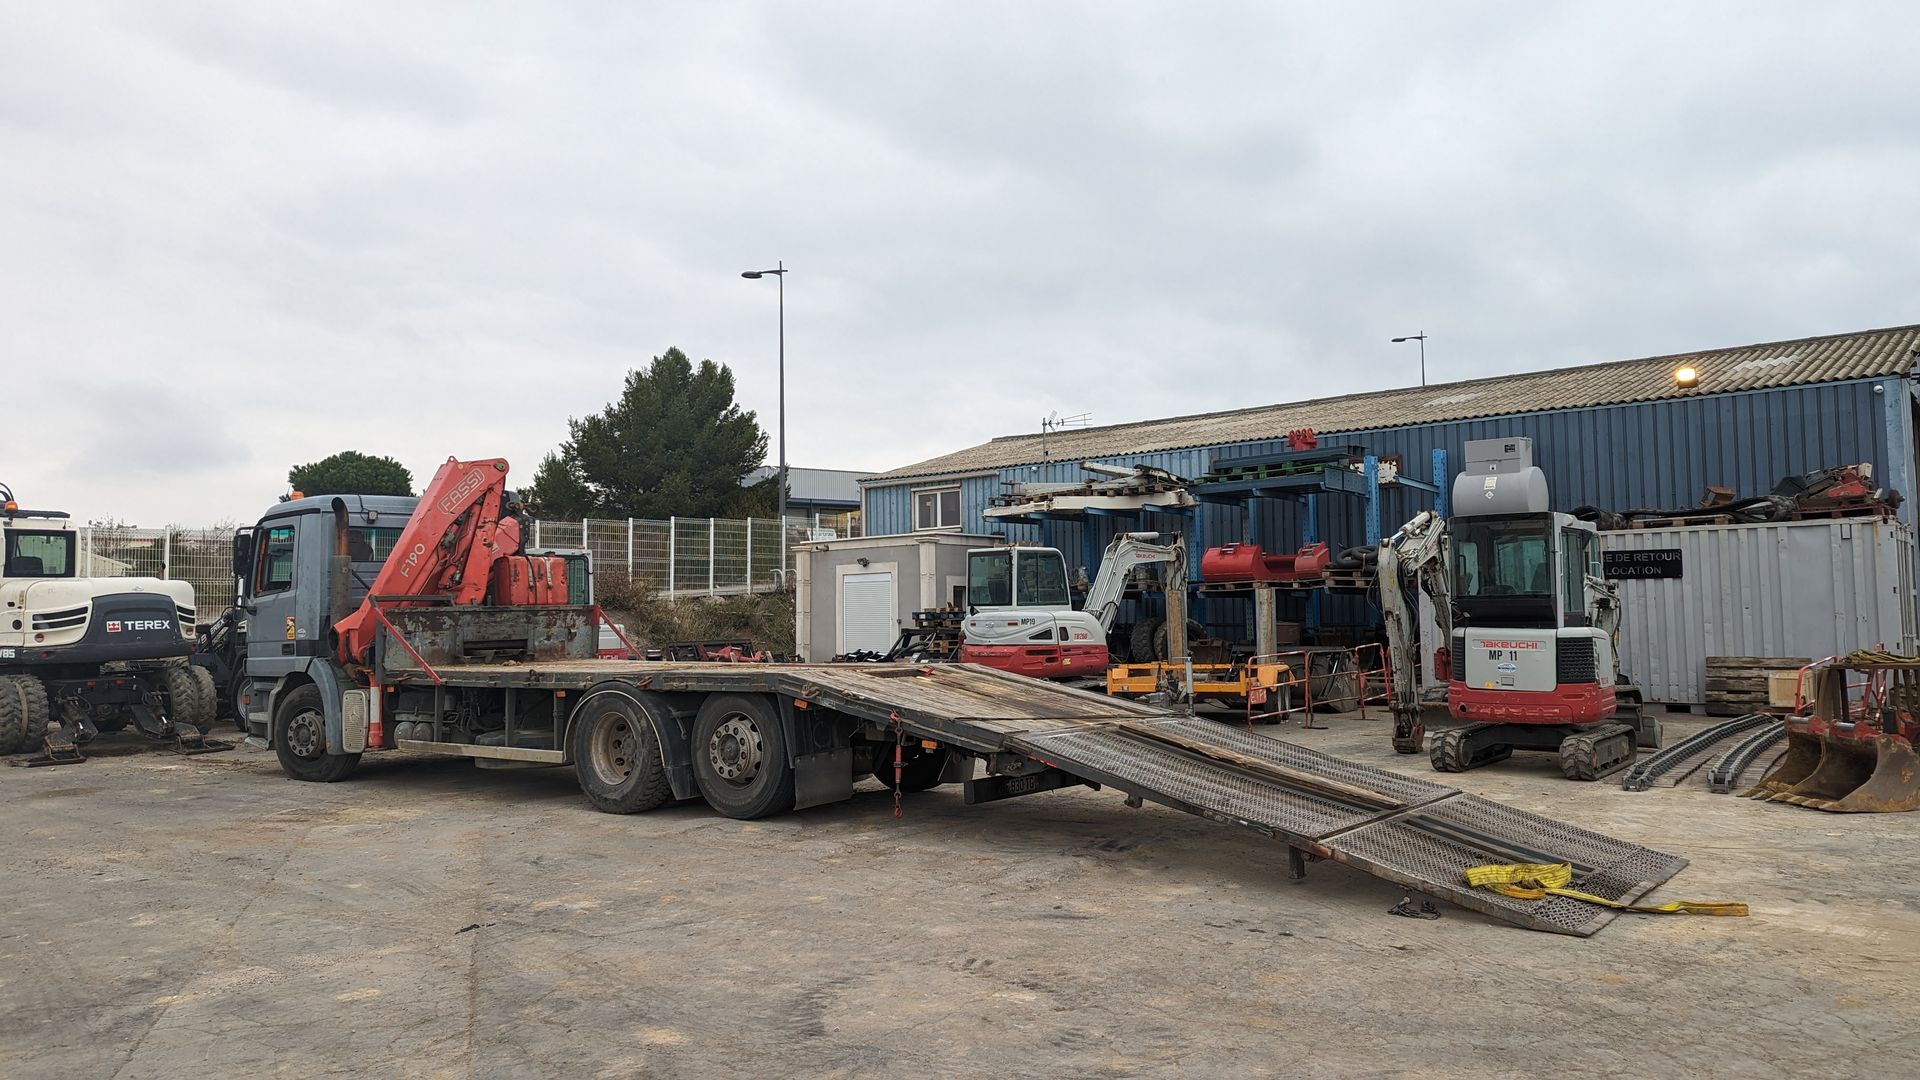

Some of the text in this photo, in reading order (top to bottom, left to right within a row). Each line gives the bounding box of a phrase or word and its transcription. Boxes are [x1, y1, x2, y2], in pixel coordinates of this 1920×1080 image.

[441, 471, 482, 512] FASSI
[400, 543, 426, 578] F190
[1616, 553, 1631, 562] DE
[1634, 552, 1680, 562] RETOUR
[1606, 566, 1661, 576] LOCATION
[124, 620, 170, 631] TEREX
[1480, 641, 1538, 649] TAKEUCHI
[1488, 650, 1518, 661] MP 11
